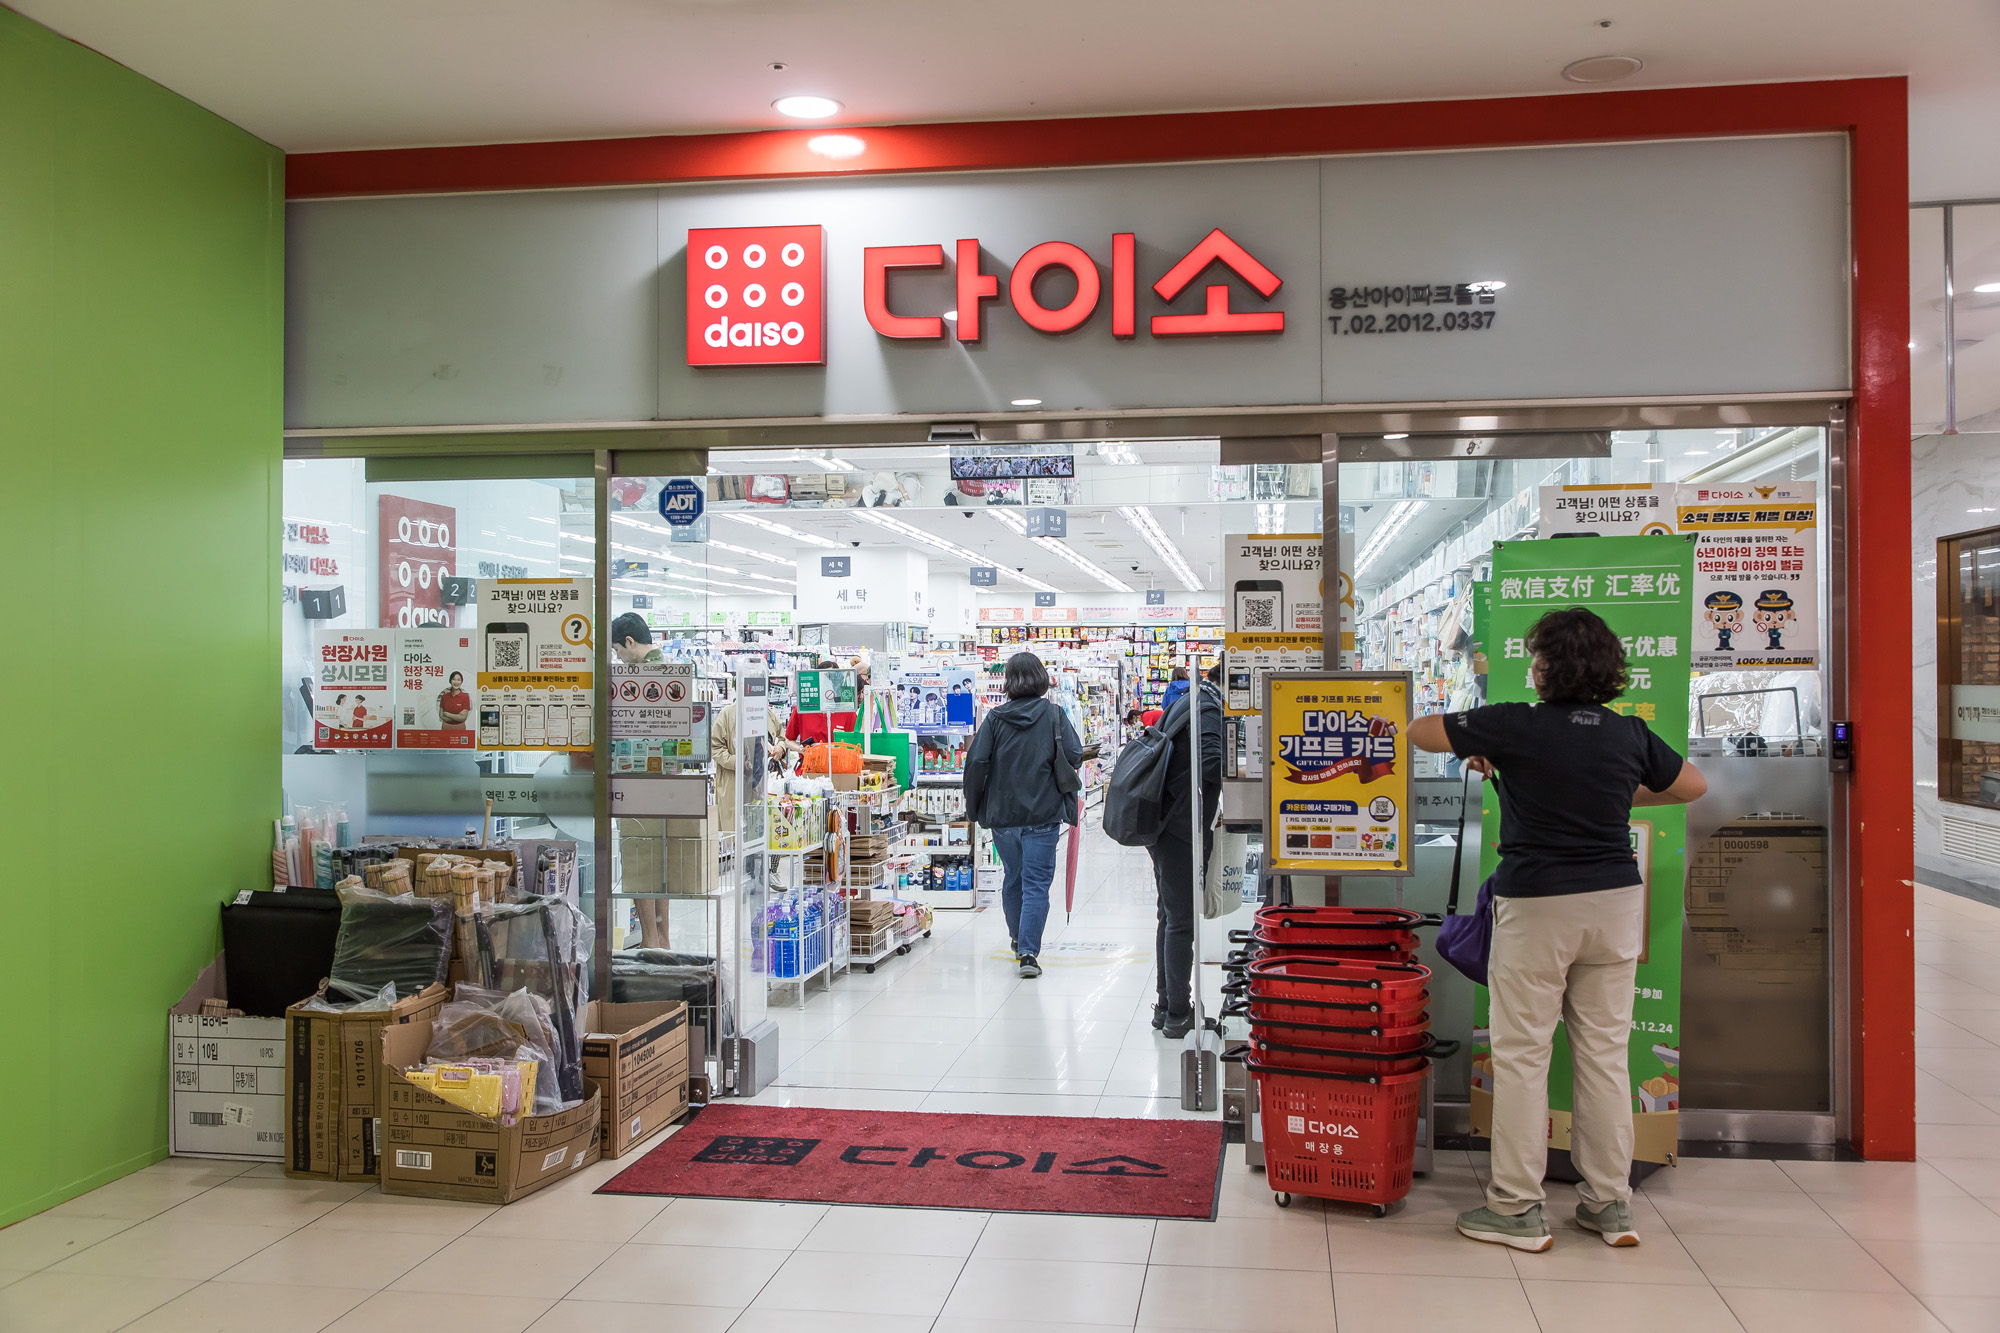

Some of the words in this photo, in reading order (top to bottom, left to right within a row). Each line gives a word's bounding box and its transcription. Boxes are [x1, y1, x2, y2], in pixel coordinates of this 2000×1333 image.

[864, 228, 1284, 343] 다이소
[1329, 311, 1496, 335] T.02.2012.0337
[704, 316, 805, 348] daiso
[1711, 490, 1744, 499] 다이소
[665, 494, 697, 511] ADT
[1555, 497, 1594, 510] 고객님!
[1598, 496, 1621, 509] 어떤
[1624, 495, 1659, 508] 상품을
[1575, 510, 1640, 524] 찾으시나요?
[1682, 512, 1709, 523] 소액
[1753, 511, 1780, 522] 처벌
[1783, 510, 1814, 522] 대상!
[1240, 546, 1277, 557] 고객님!
[1281, 546, 1302, 557] 어떤
[1755, 546, 1777, 557] 징역
[1781, 546, 1805, 557] 또는
[1259, 560, 1320, 571] 찾으시나요?
[1698, 560, 1738, 572] 1천만원
[1741, 560, 1777, 571] 이하의
[1780, 560, 1803, 571] 벌금
[451, 583, 460, 597] 2
[470, 584, 475, 598] 2
[1500, 575, 1595, 600] 微信支付
[1605, 573, 1681, 597] 汇率优
[335, 594, 341, 609] 1
[491, 590, 523, 601] 고객님!
[527, 590, 546, 600] 어떤
[549, 589, 579, 600] 상품을
[313, 597, 320, 612] 1
[507, 603, 563, 614] 찾으시나요?
[321, 645, 388, 662] 현장사원
[403, 653, 432, 664] 다이소
[1736, 657, 1764, 665] 100%
[1766, 657, 1814, 665] 보이스피싱!
[321, 665, 387, 682] 상시모집
[403, 665, 423, 677] 현장
[424, 665, 444, 677] 직원
[612, 666, 640, 674] 10:00
[662, 666, 690, 675] 22:00
[403, 679, 423, 691] 채용
[1629, 668, 1652, 689] 元
[1296, 695, 1318, 703] 선물용
[1321, 695, 1344, 703] 기프트
[1346, 695, 1362, 703] 카드
[1364, 695, 1383, 703] 판매!
[611, 709, 635, 718] CCTV
[639, 709, 671, 718] 설치안내
[1304, 711, 1368, 733] 다이소
[1280, 736, 1344, 758] 기프트
[1351, 736, 1394, 758] 카드
[508, 790, 517, 800] 후
[1286, 803, 1322, 811] 카운터에서
[1323, 803, 1352, 812] 구매가능
[1724, 840, 1769, 850] 0000598
[202, 1042, 218, 1061] 10입
[354, 1040, 366, 1088] 1011706
[176, 1070, 197, 1086] 제조일자
[235, 1072, 256, 1089] 유통기한
[415, 1092, 433, 1104] 접이식
[415, 1114, 430, 1125] 10입
[1308, 1120, 1360, 1139] 다이소
[256, 1132, 269, 1142] MADE
[268, 1133, 273, 1142] IN
[274, 1132, 285, 1143] KORE
[390, 1129, 411, 1140] 제조일자
[446, 1133, 466, 1145] 유통기한
[524, 1135, 549, 1148] 제조일자
[353, 1149, 360, 1159] 12
[708, 1153, 789, 1163] daiso
[838, 1145, 1169, 1177] 다이소
[458, 1176, 473, 1184] MADE
[480, 1177, 497, 1185] CHINA
